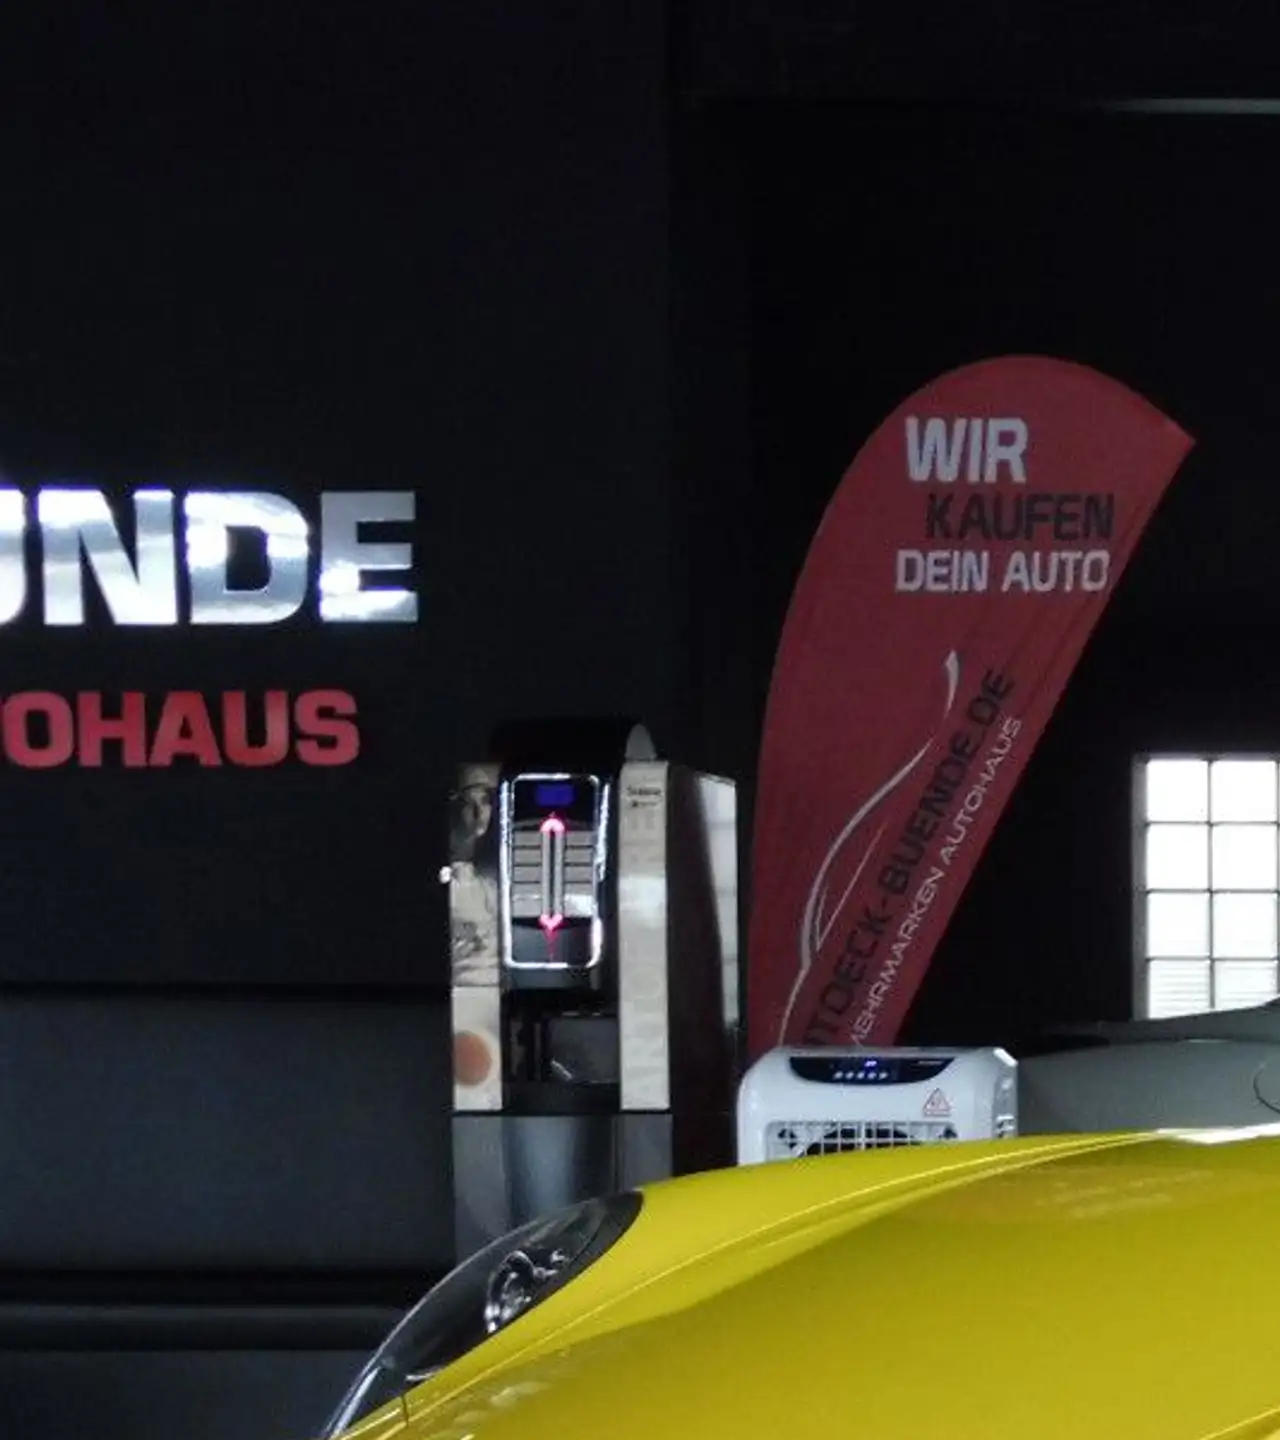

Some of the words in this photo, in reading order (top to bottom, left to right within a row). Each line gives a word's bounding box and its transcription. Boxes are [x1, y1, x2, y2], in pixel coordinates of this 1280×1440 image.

[905, 415, 1028, 484] WIR
[925, 492, 1115, 541] KAUFEN
[895, 549, 989, 593] DEIN
[1000, 549, 1110, 593] AUTO
[3, 689, 360, 768] OHAUS
[941, 716, 1022, 865] AUTOHAUS
